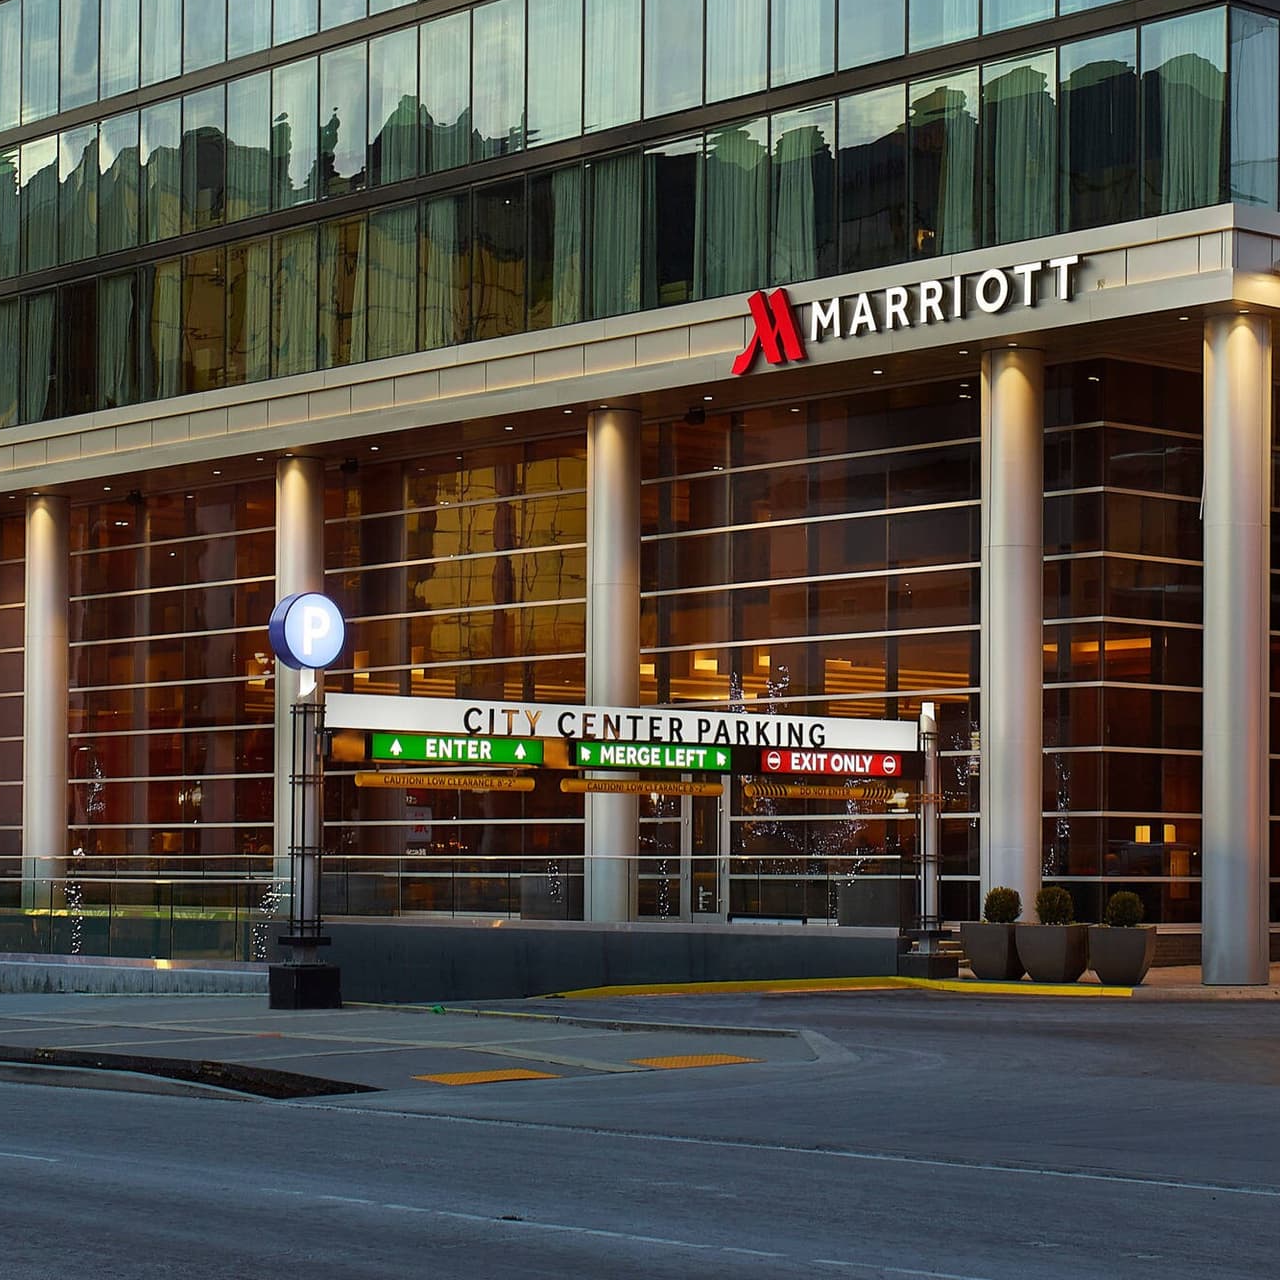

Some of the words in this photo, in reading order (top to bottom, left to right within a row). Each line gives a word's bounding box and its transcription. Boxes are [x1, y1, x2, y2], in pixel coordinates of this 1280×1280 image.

[810, 255, 1084, 342] MARRIOTT
[303, 606, 330, 656] P
[463, 707, 543, 737] CITY
[557, 712, 683, 743] CENTER
[698, 718, 825, 748] PARKING
[425, 738, 492, 759] ENTER
[600, 745, 661, 766] MERGE
[665, 748, 707, 768] LEFT
[791, 752, 827, 772] EXIT
[830, 754, 873, 773] ONLY
[427, 776, 446, 785] LOW
[447, 777, 493, 787] CLEARANCE
[626, 783, 644, 792] LOW
